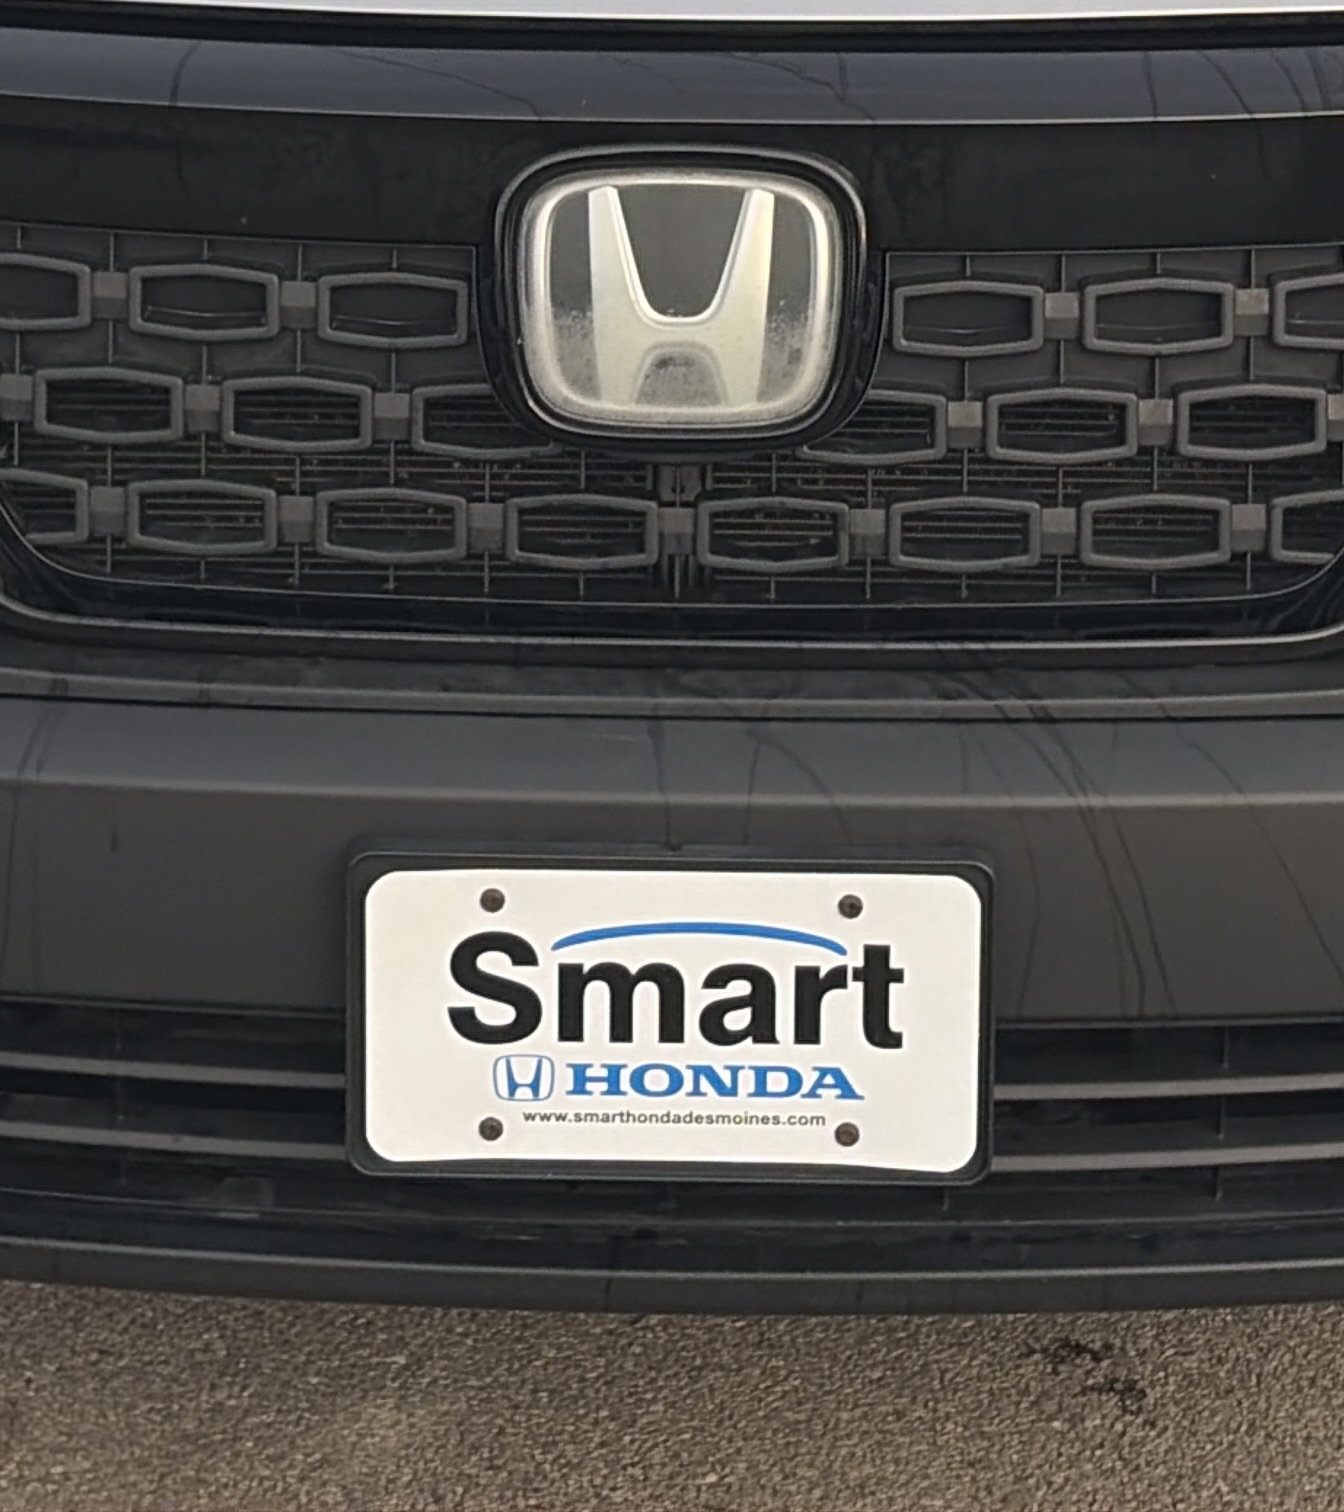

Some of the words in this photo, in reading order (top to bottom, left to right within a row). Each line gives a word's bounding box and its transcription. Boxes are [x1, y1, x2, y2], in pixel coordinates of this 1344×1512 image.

[447, 931, 905, 1049] Smart
[565, 1063, 865, 1101] HONDA
[522, 1110, 826, 1127] www.smarthondadesmoines.com
